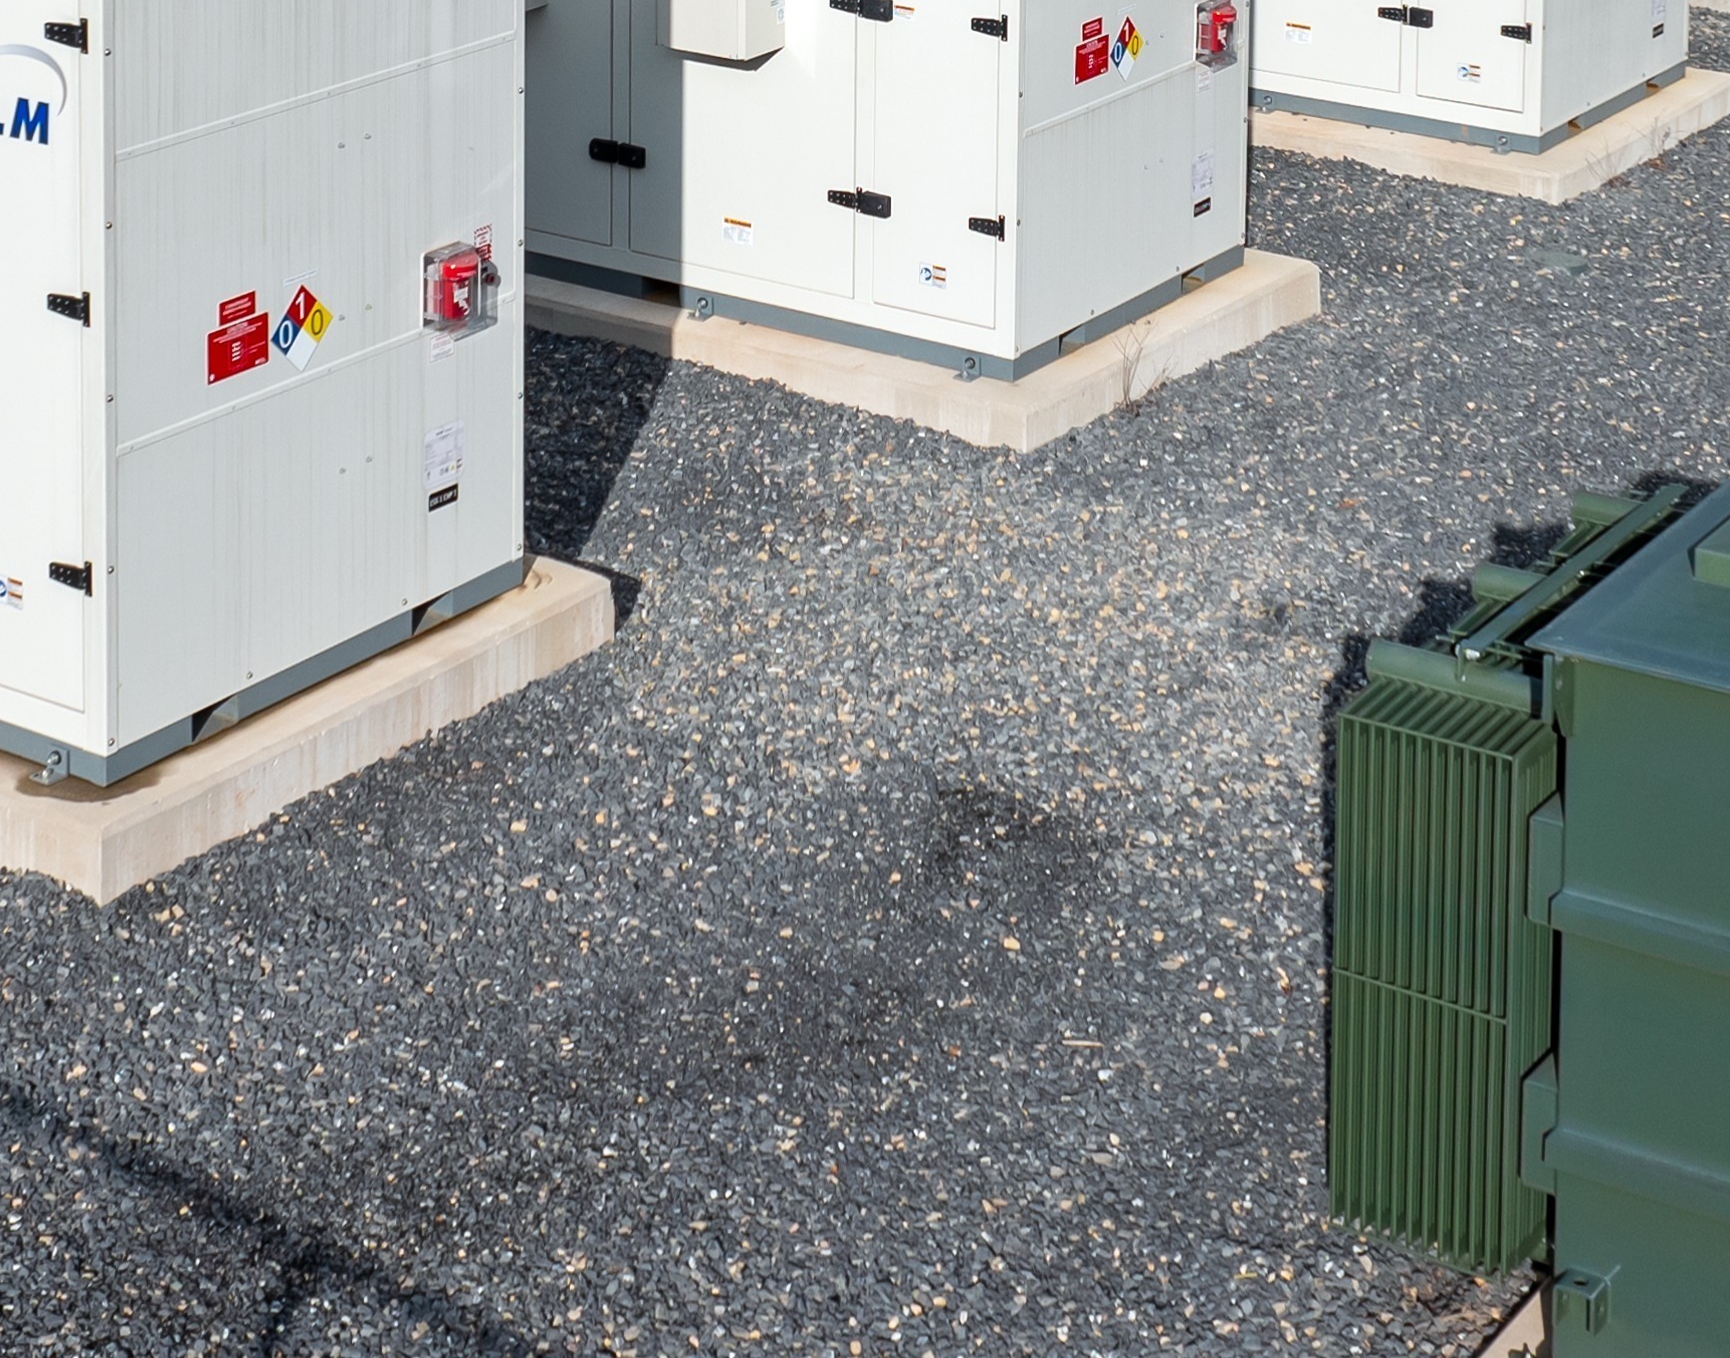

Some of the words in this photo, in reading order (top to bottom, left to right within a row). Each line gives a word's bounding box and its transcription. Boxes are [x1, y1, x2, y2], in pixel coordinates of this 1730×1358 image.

[1123, 21, 1129, 43] 1
[1114, 41, 1123, 63] 0
[1131, 34, 1139, 56] 0
[295, 292, 305, 320] 1
[278, 319, 293, 349] 0
[310, 308, 324, 336] 0
